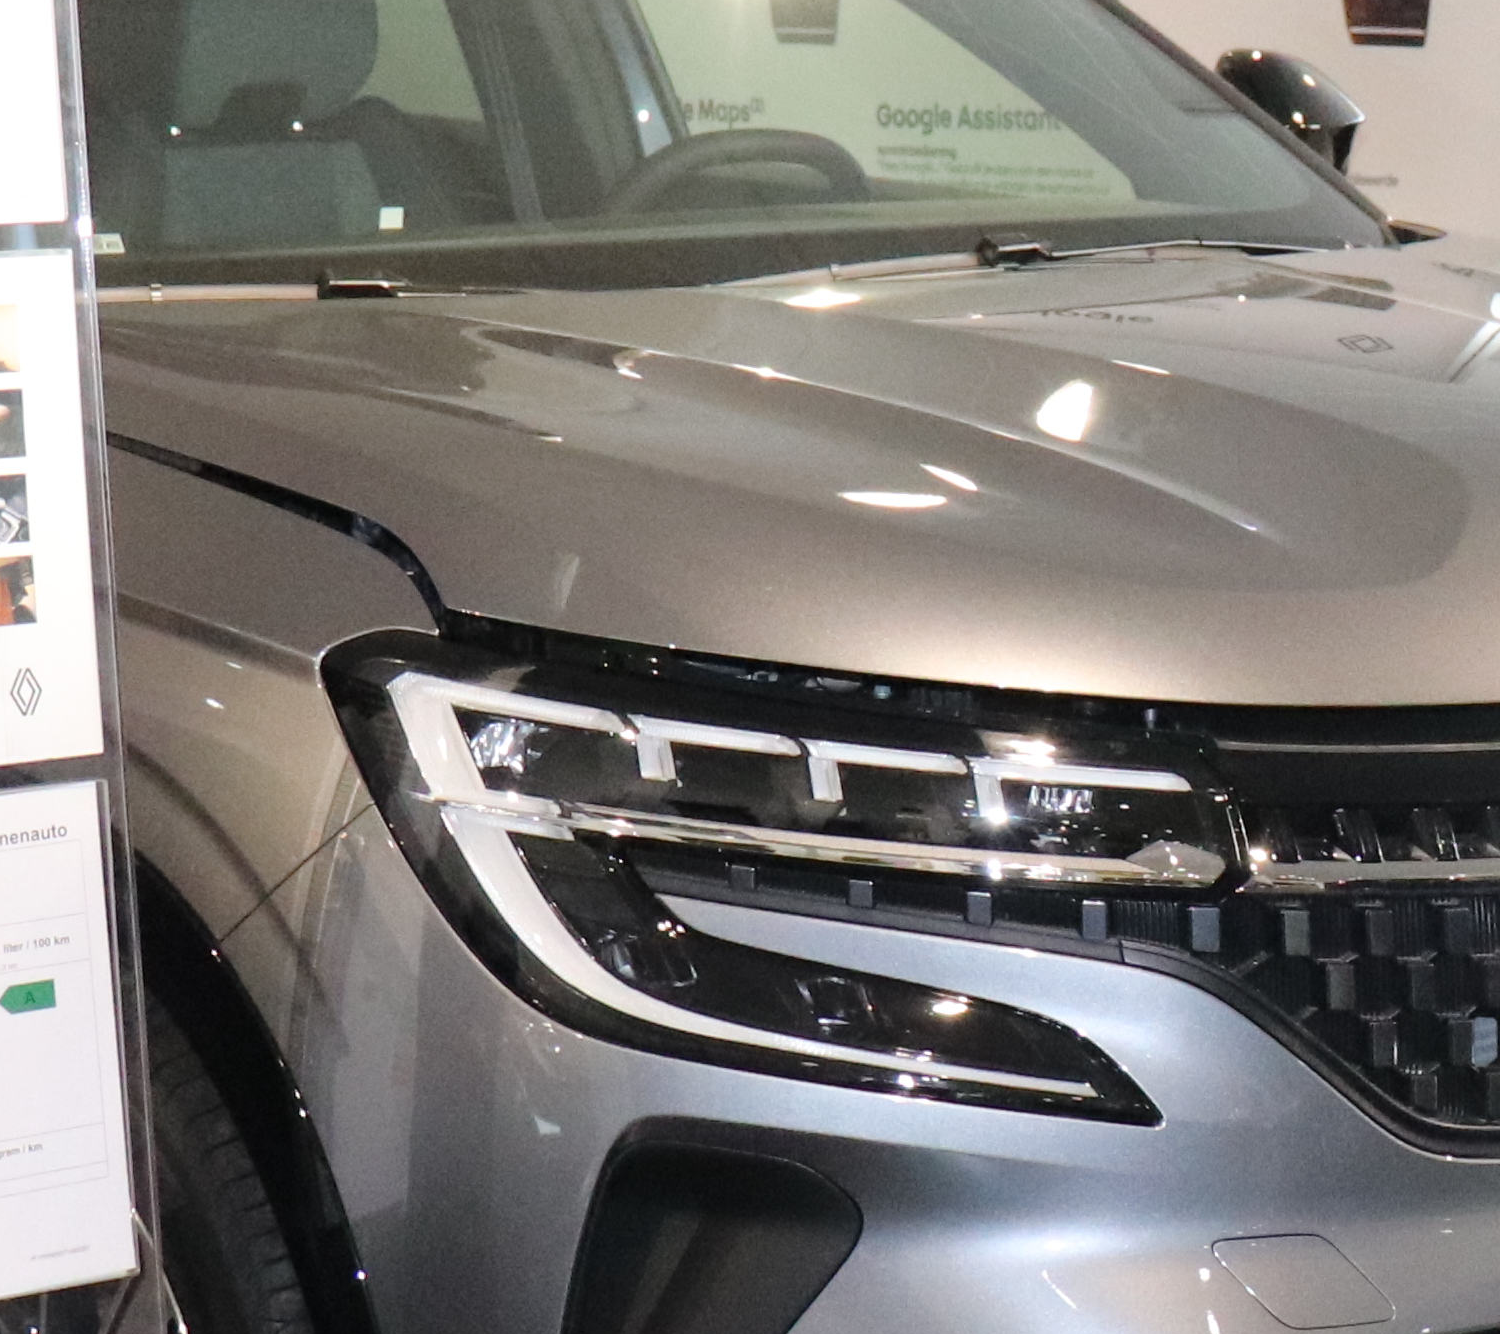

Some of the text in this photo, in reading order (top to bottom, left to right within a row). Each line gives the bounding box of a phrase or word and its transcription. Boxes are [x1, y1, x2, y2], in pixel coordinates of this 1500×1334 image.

[877, 102, 952, 135] Google
[33, 938, 51, 950] 100
[53, 935, 70, 945] km
[24, 991, 36, 1005] A
